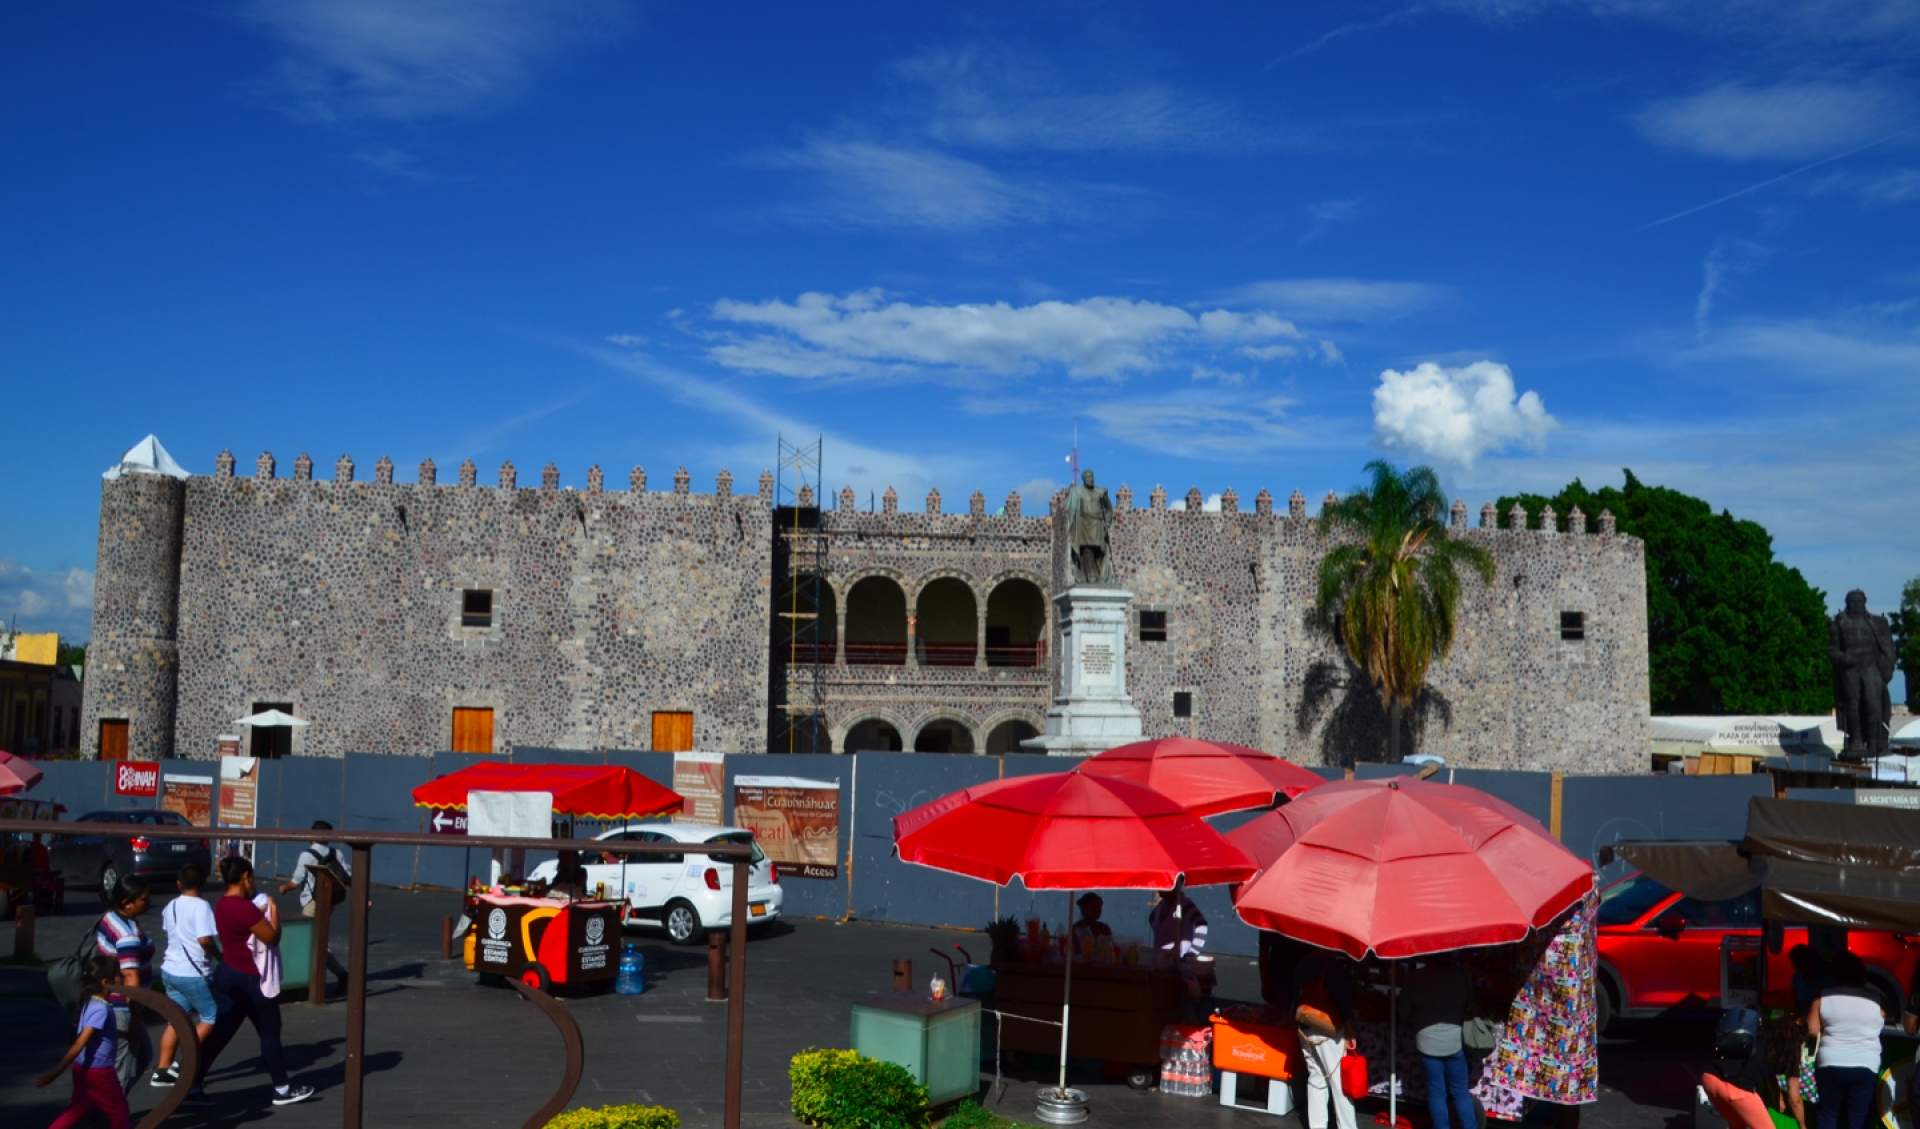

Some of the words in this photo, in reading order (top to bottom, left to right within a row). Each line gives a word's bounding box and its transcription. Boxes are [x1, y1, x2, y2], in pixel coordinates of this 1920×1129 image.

[135, 770, 157, 787] INAH
[767, 795, 837, 810] Cuauhnáhuac
[1860, 796, 1869, 805] LA
[1870, 794, 1909, 805] SECRETARÍA
[1910, 796, 1919, 805] DE
[803, 864, 835, 877] Acceso
